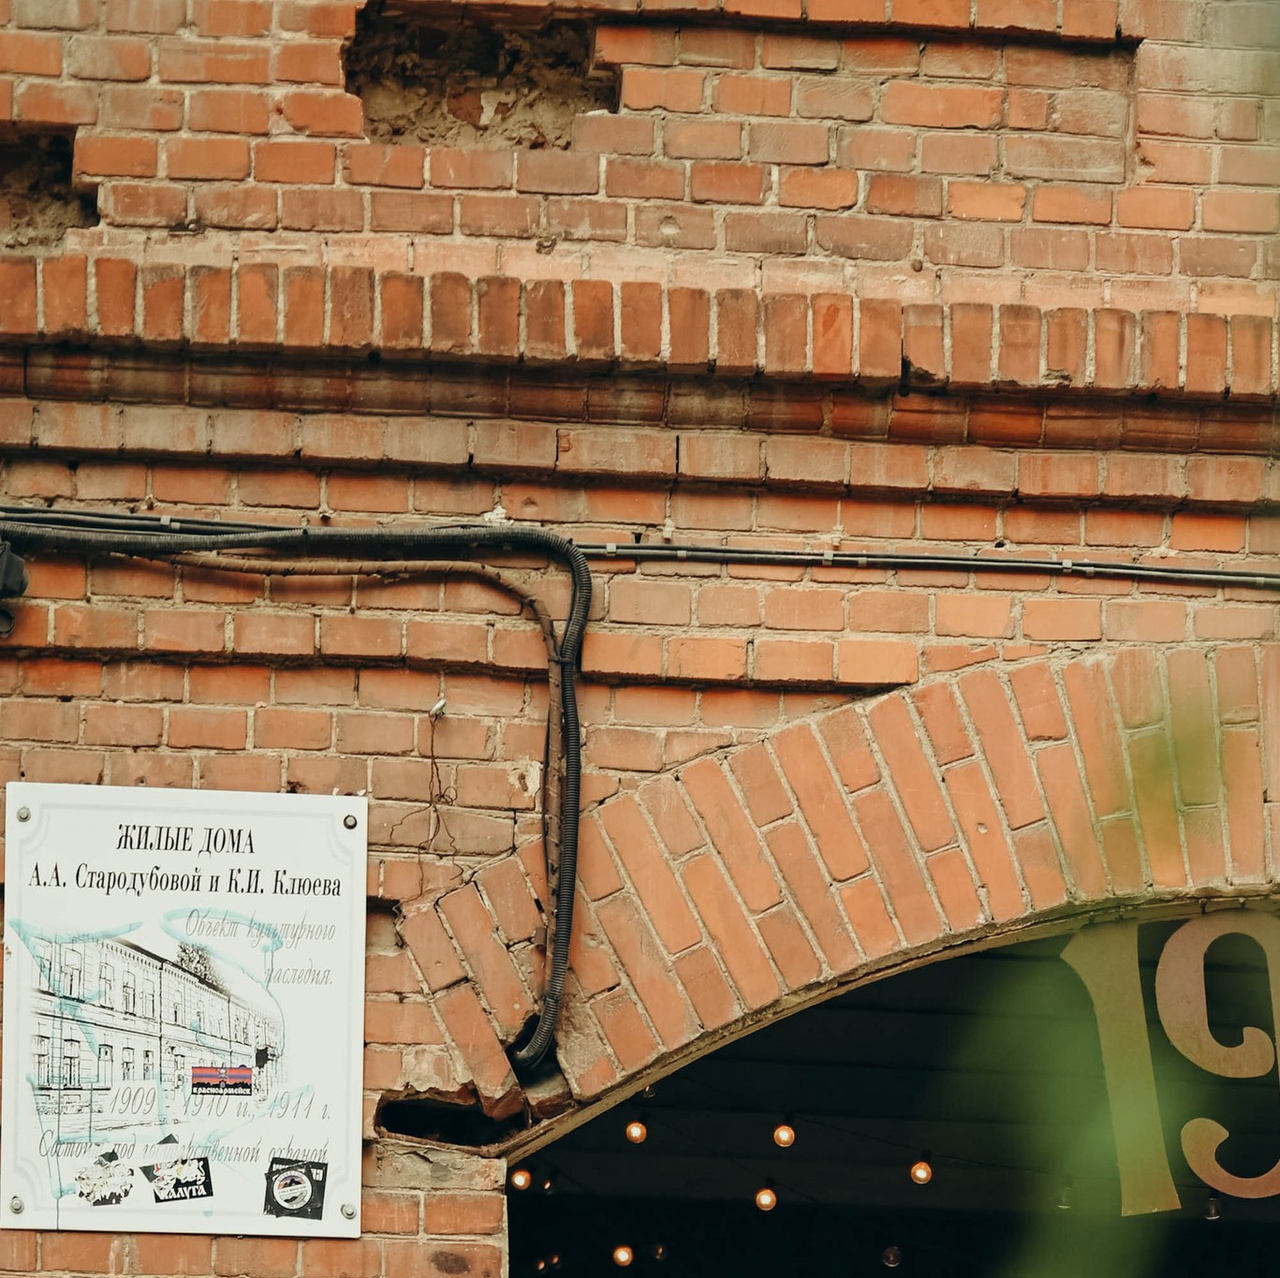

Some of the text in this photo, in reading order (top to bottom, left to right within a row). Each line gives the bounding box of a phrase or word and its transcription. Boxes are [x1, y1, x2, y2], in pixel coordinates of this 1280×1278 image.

[116, 824, 255, 859] ЖИЛЫЕ ДОМА
[28, 862, 341, 897] А.А. Стародубовой и К.И. Клюева
[185, 908, 336, 950] Объект культурного
[110, 1086, 157, 1115] 1909
[182, 1093, 229, 1118] 1910
[268, 1090, 315, 1119] 1911
[39, 1129, 100, 1158] Состои
[112, 1132, 137, 1159] под
